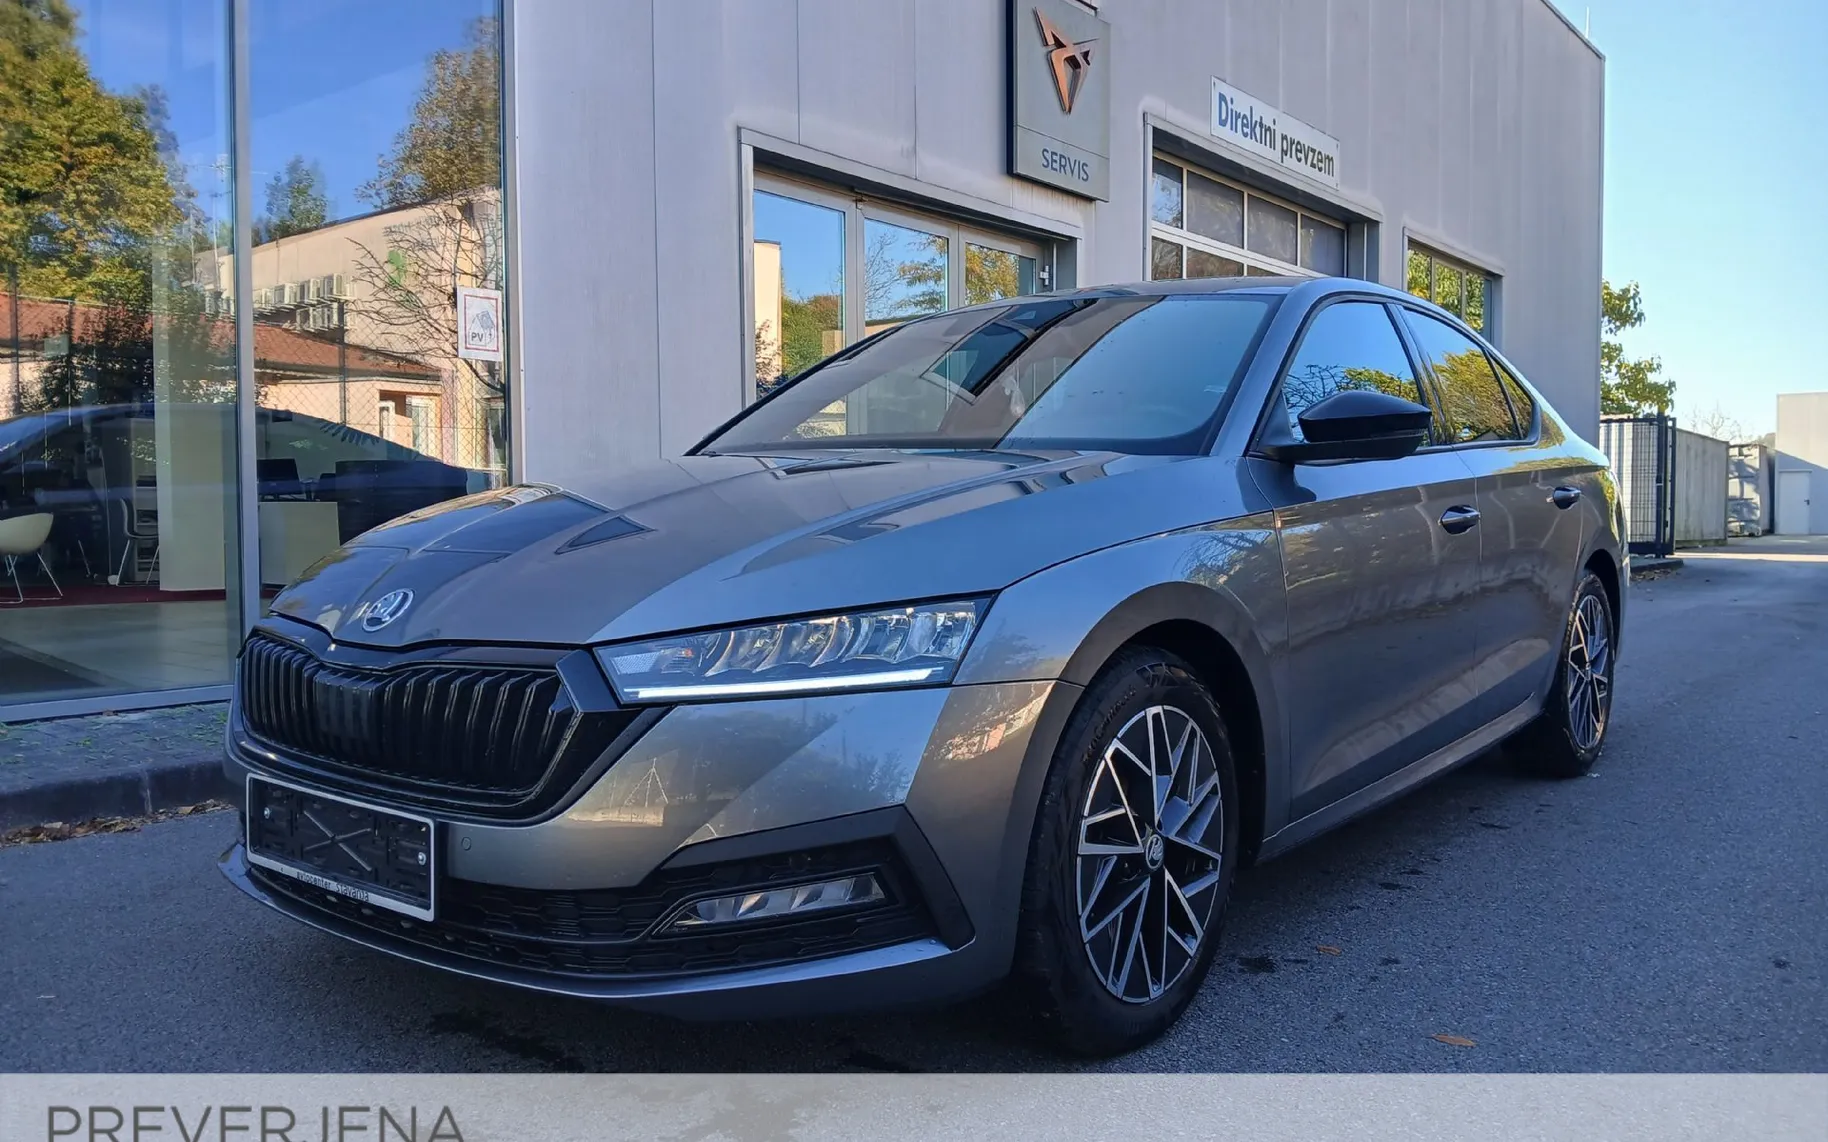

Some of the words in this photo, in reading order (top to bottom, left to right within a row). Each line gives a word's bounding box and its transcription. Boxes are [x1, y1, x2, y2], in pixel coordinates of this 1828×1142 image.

[1217, 91, 1277, 151] Direktni
[1280, 133, 1335, 177] prevzem
[1041, 147, 1089, 182] SERVIS
[471, 332, 484, 342] PV
